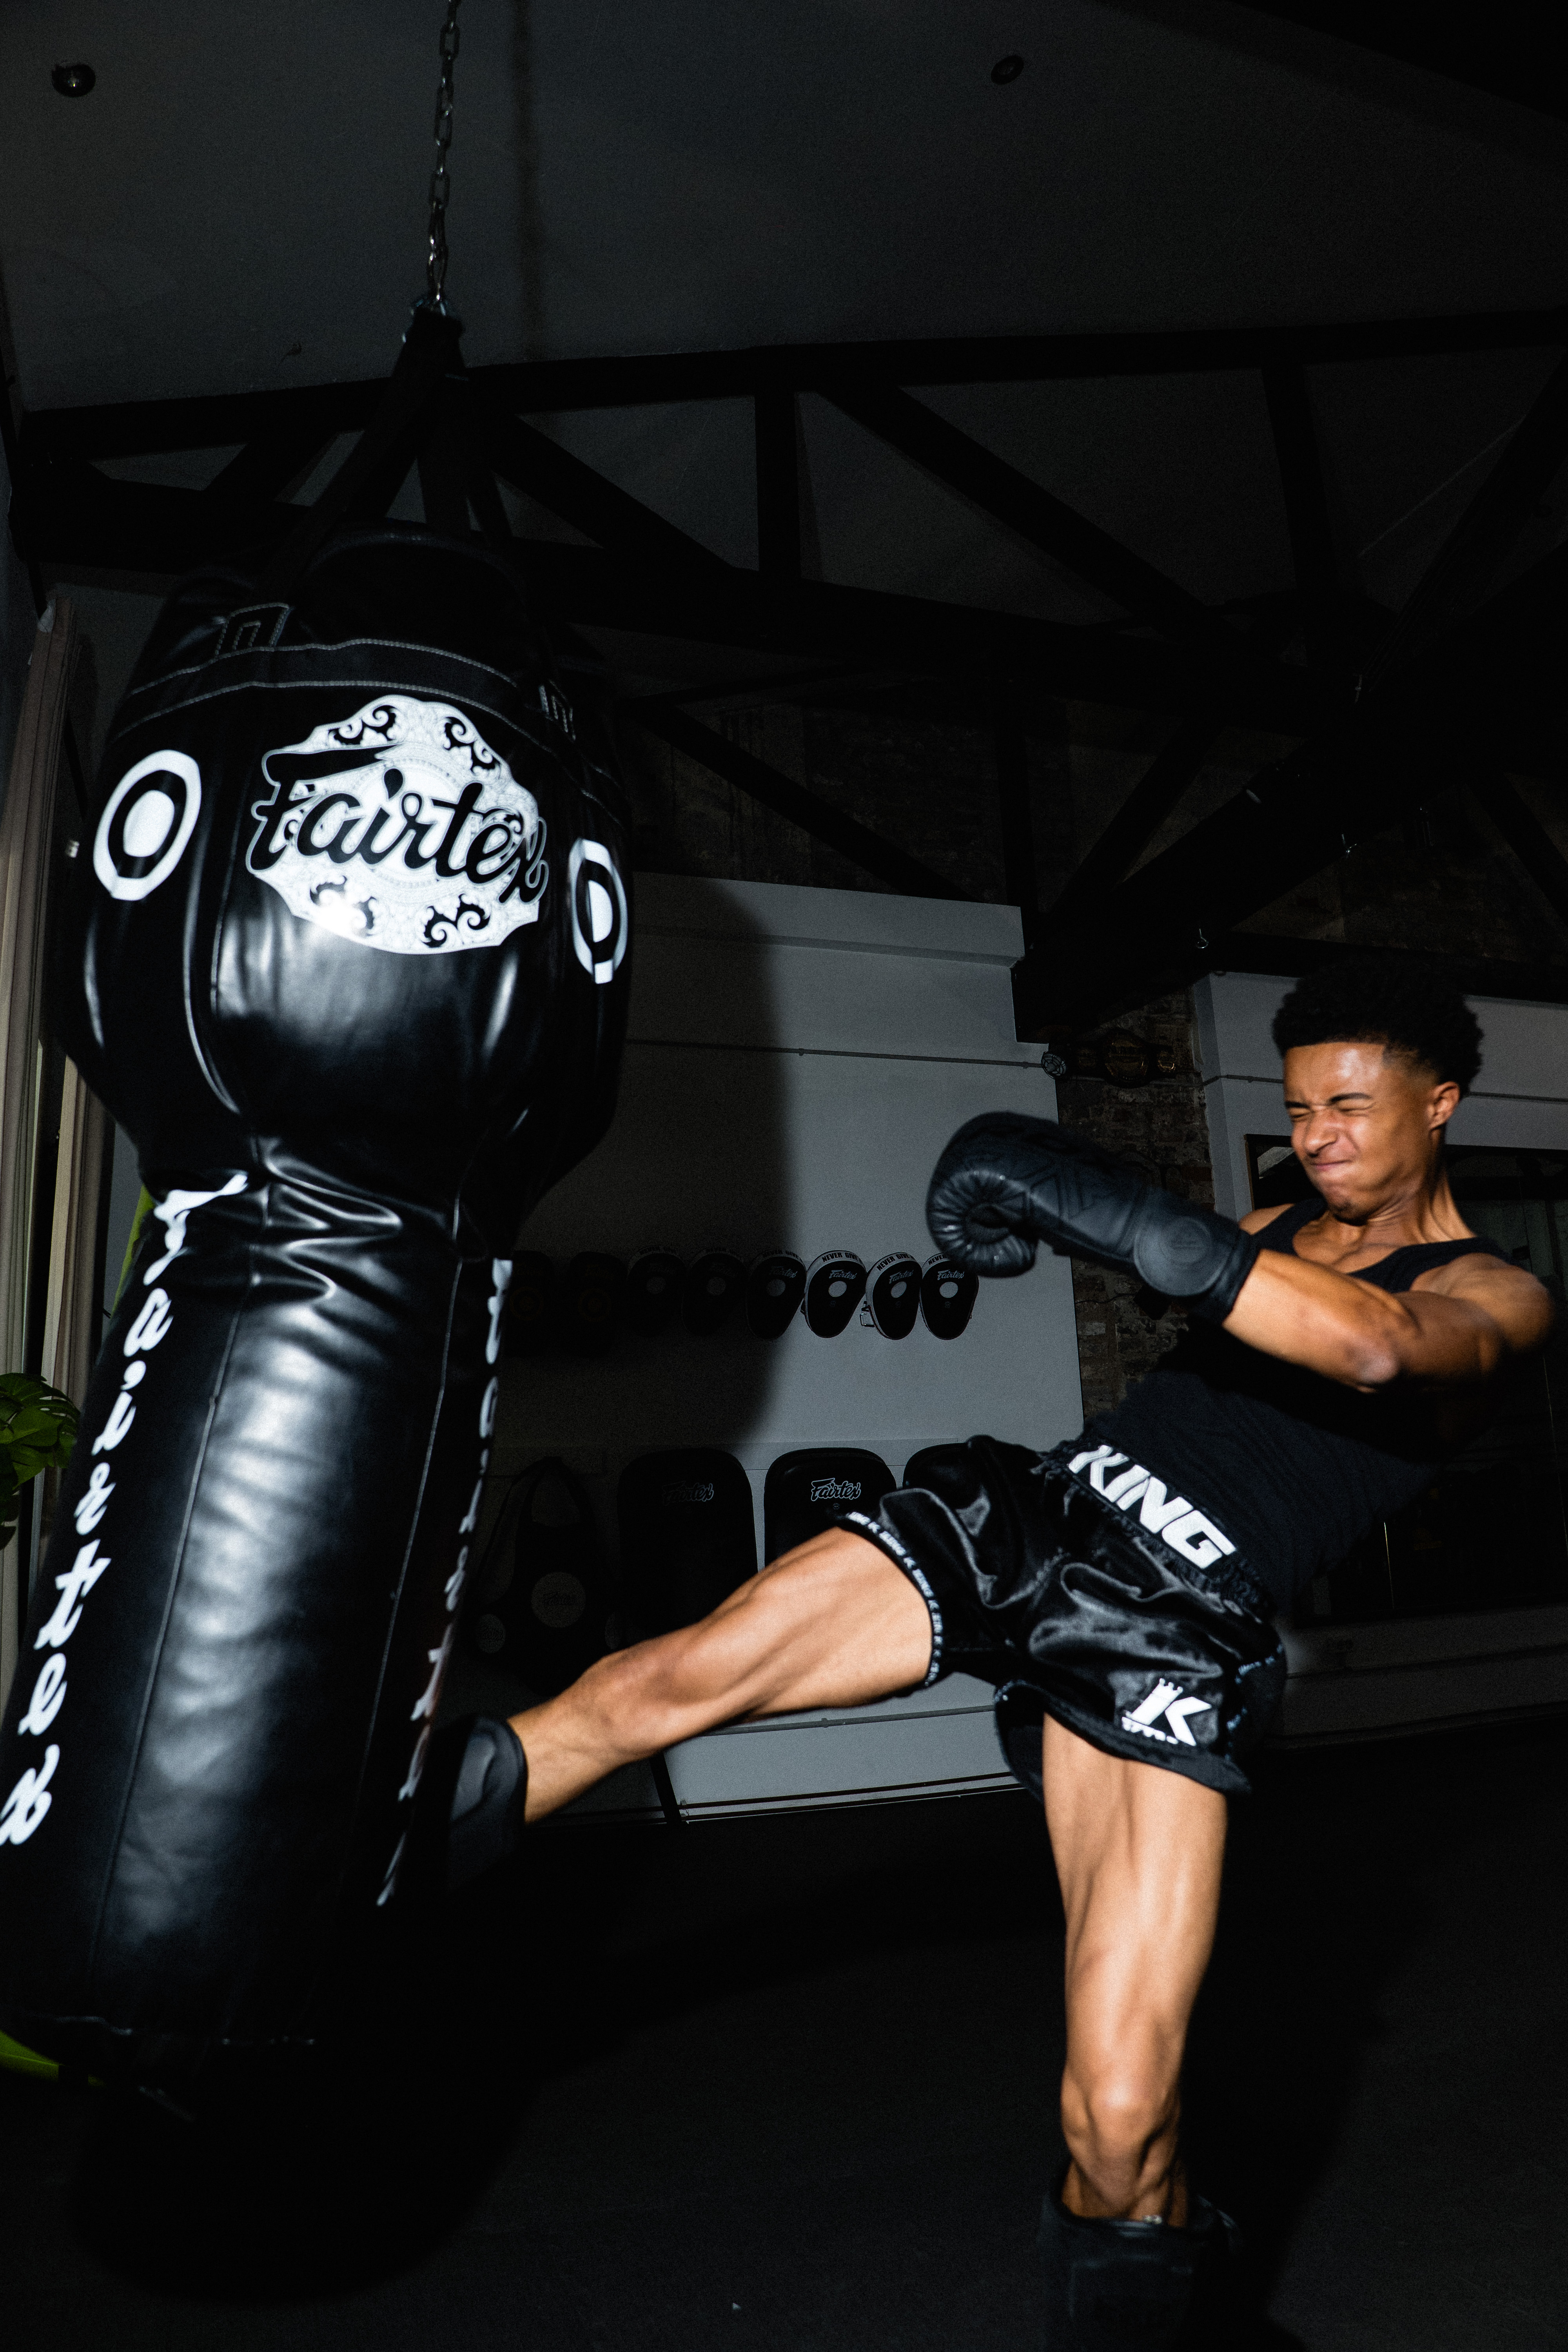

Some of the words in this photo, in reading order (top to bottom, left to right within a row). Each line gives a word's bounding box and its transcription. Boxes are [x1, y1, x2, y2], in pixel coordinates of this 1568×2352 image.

[246, 743, 549, 904] Fairtex
[822, 1252, 842, 1263] NEVER
[845, 1252, 858, 1261] GIVE
[876, 1256, 895, 1271] NEVER
[828, 1269, 857, 1280] Fairtex
[889, 1269, 914, 1284] Fairtex
[937, 1269, 965, 1281] Fairtex
[661, 1480, 715, 1506] Fairtex
[811, 1477, 862, 1502] Fairtex
[1067, 1445, 1236, 1570] KING
